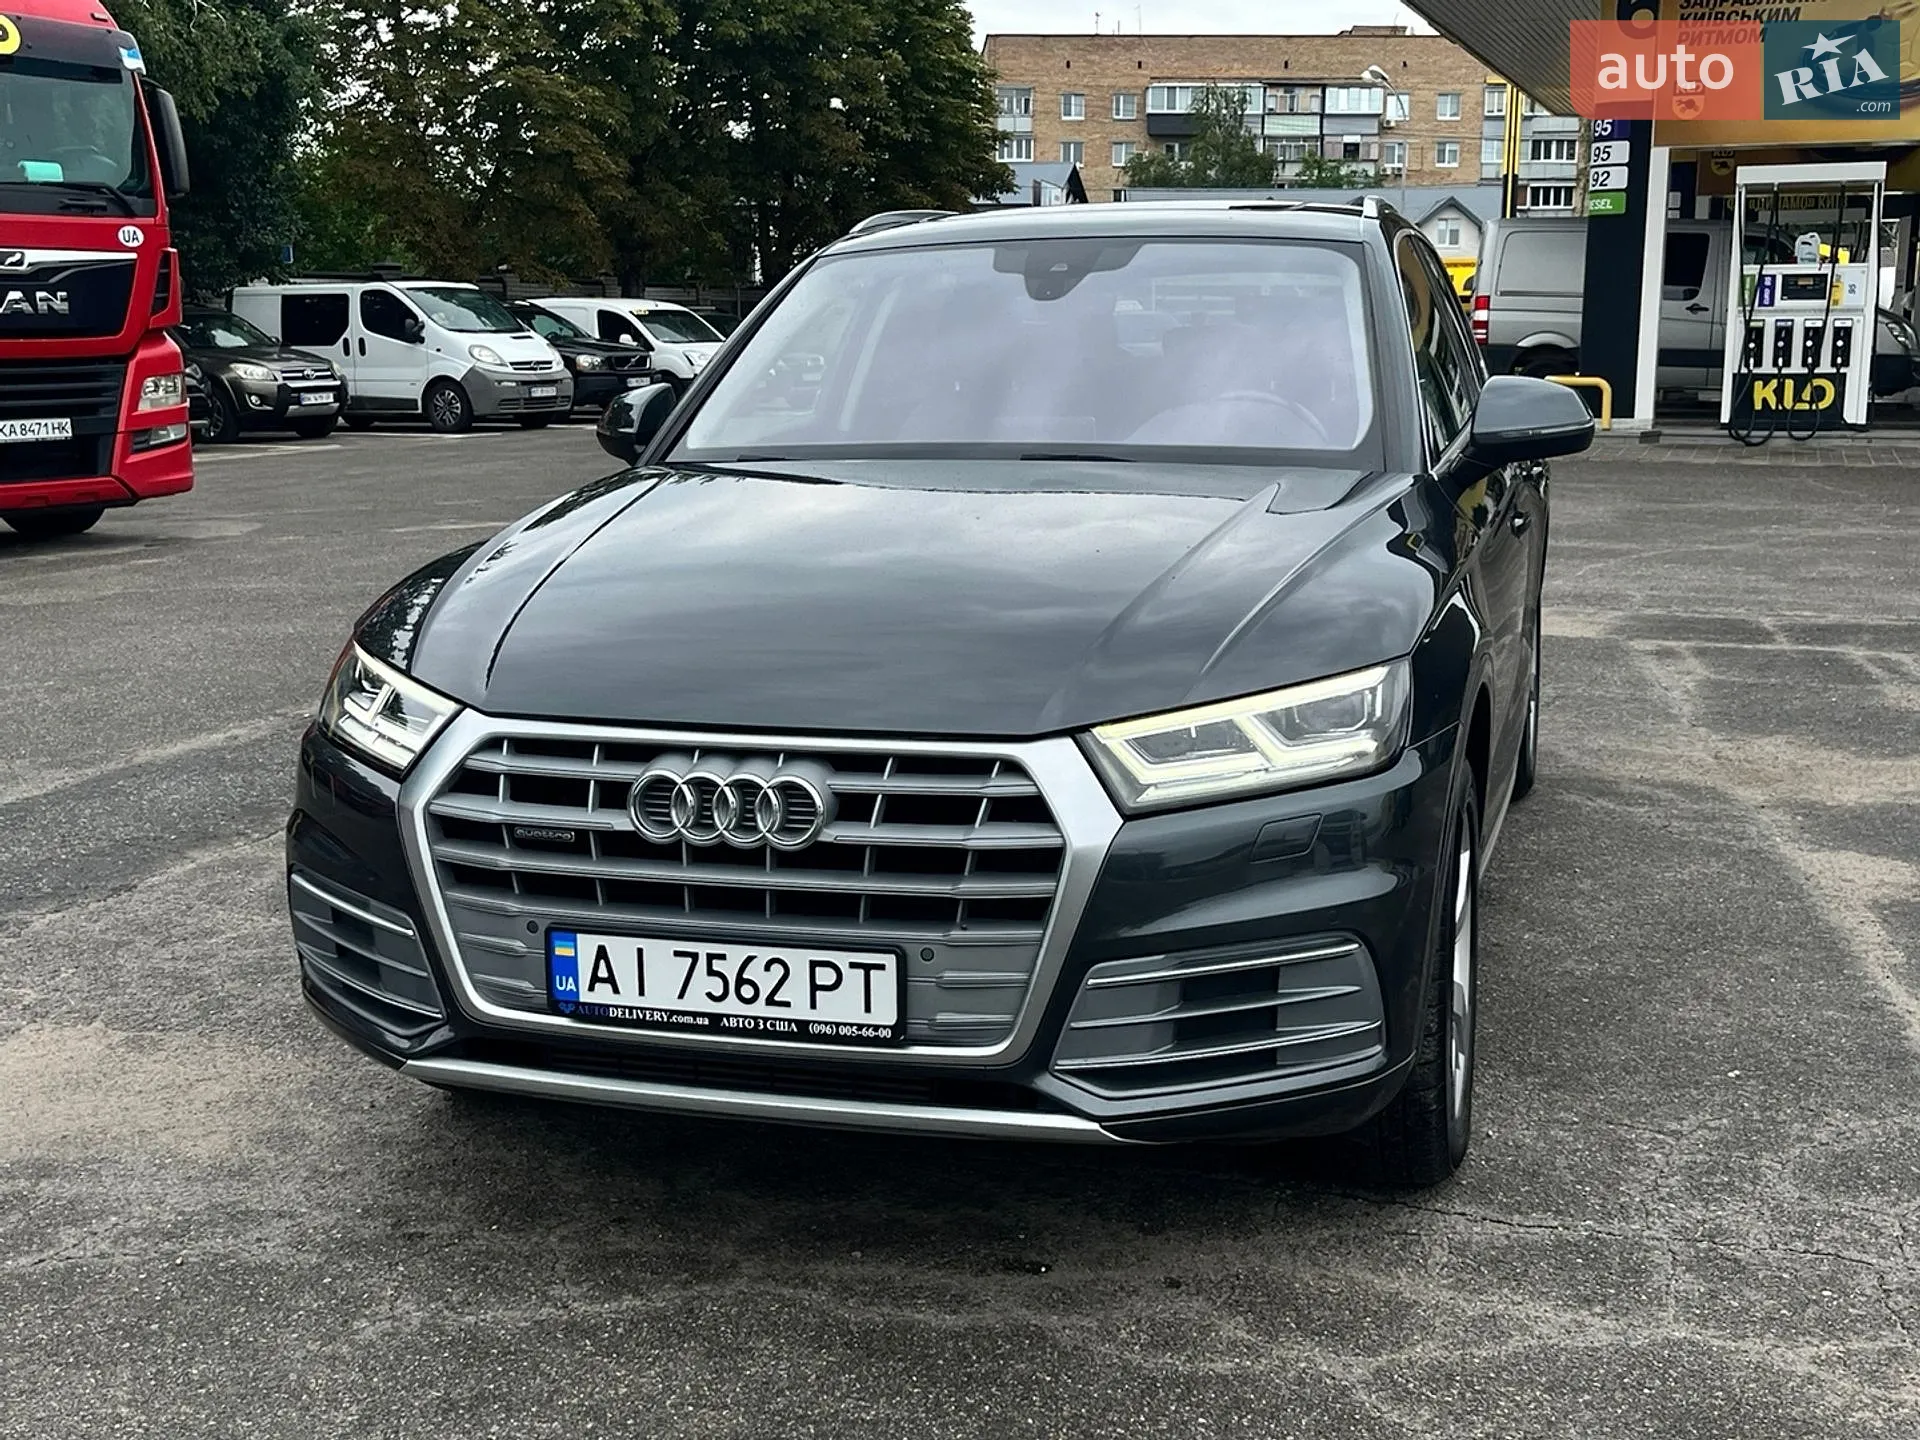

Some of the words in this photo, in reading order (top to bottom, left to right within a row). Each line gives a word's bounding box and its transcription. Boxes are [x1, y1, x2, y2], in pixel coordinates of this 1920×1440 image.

[1677, 28, 1768, 46] РИТМОМ
[1594, 119, 1613, 137] 95
[1593, 145, 1612, 163] 95
[1591, 170, 1610, 187] 92
[122, 229, 140, 244] UA
[20, 422, 49, 436] 8471
[51, 421, 70, 435] HK
[555, 975, 577, 992] UA
[587, 944, 646, 997] AI
[673, 950, 792, 1008] 7562
[809, 959, 887, 1014] PT
[720, 1016, 755, 1029] АВТО
[808, 1023, 836, 1035] (096)
[838, 1025, 892, 1039] 005-66-00
